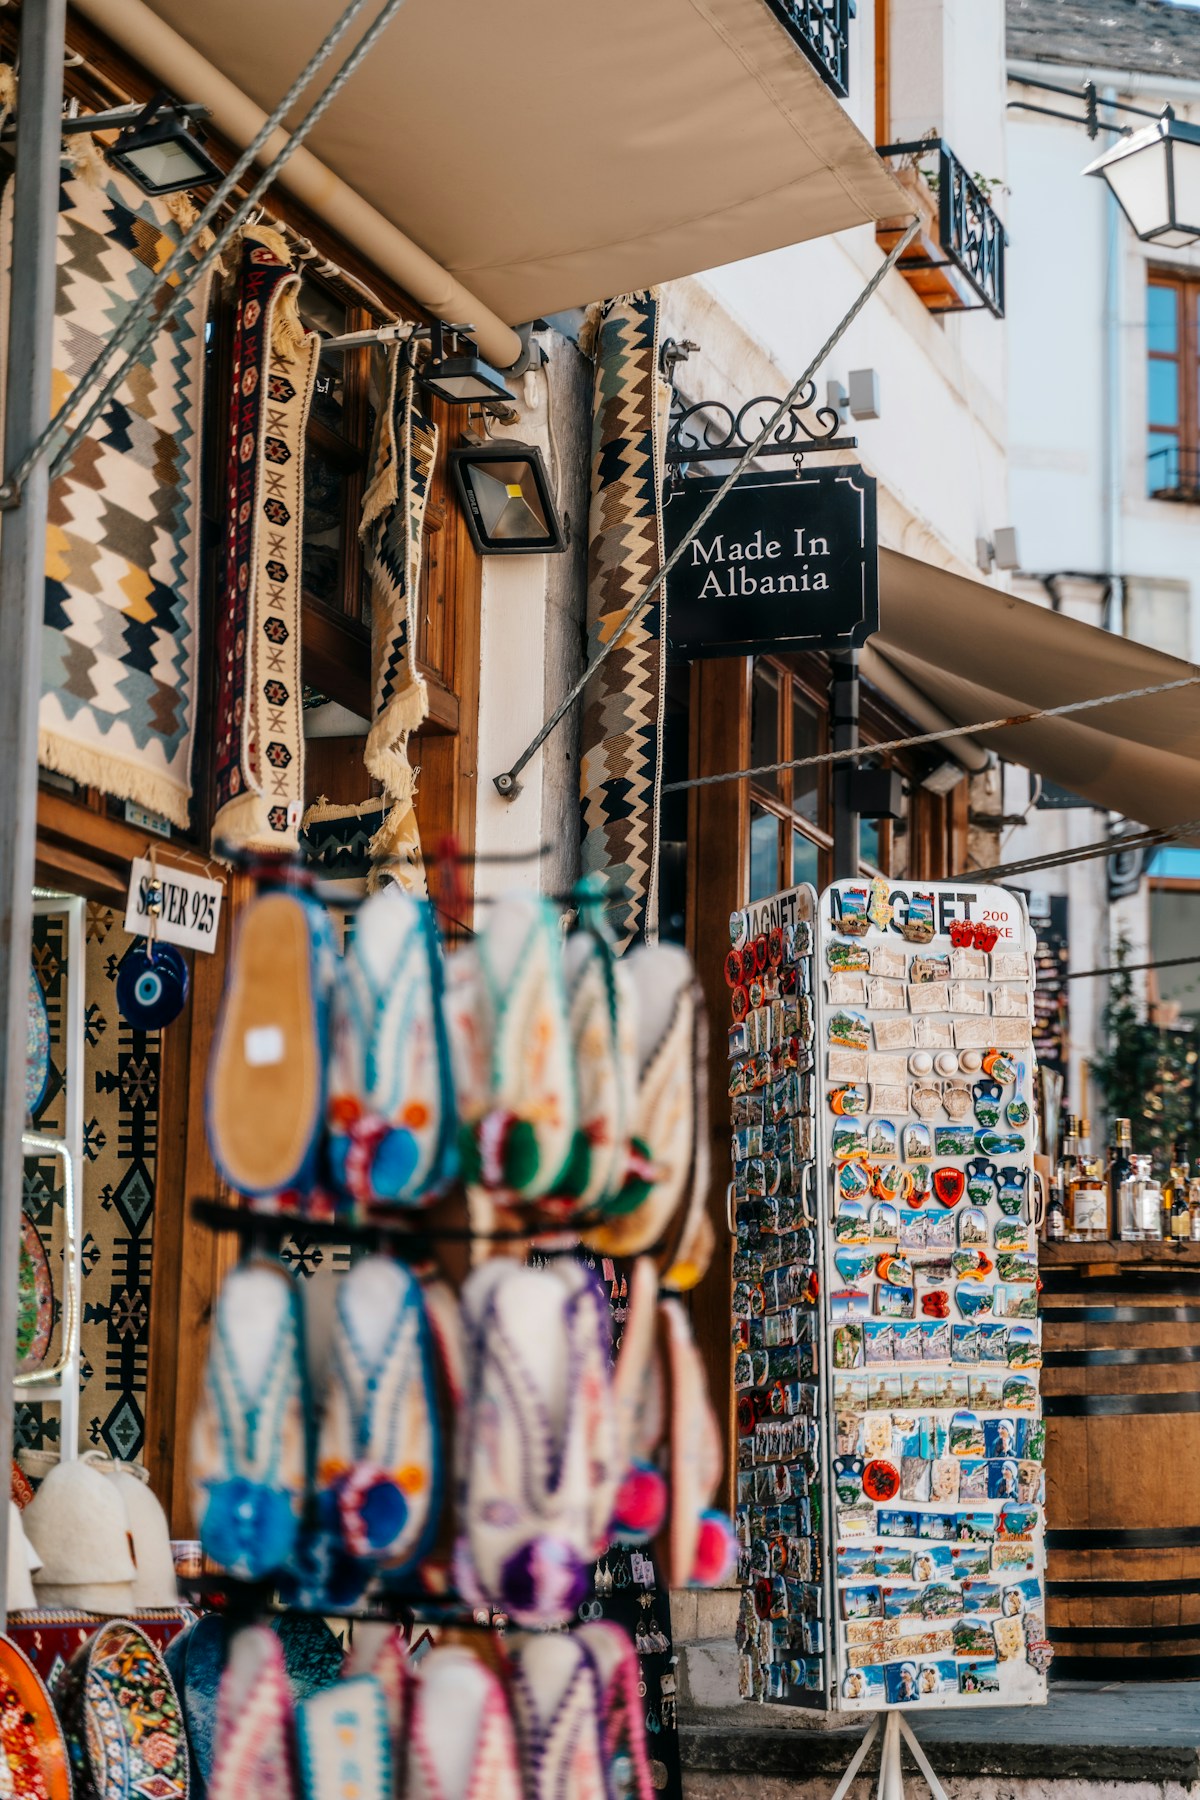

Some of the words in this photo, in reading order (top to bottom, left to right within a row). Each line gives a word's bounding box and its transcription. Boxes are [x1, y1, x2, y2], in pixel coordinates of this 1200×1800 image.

[691, 529, 782, 566] Made
[793, 528, 831, 557] In
[697, 564, 830, 599] Albania
[137, 875, 188, 927] SVER
[190, 890, 216, 934] 925
[830, 888, 977, 935] MGET
[982, 910, 1009, 922] 200
